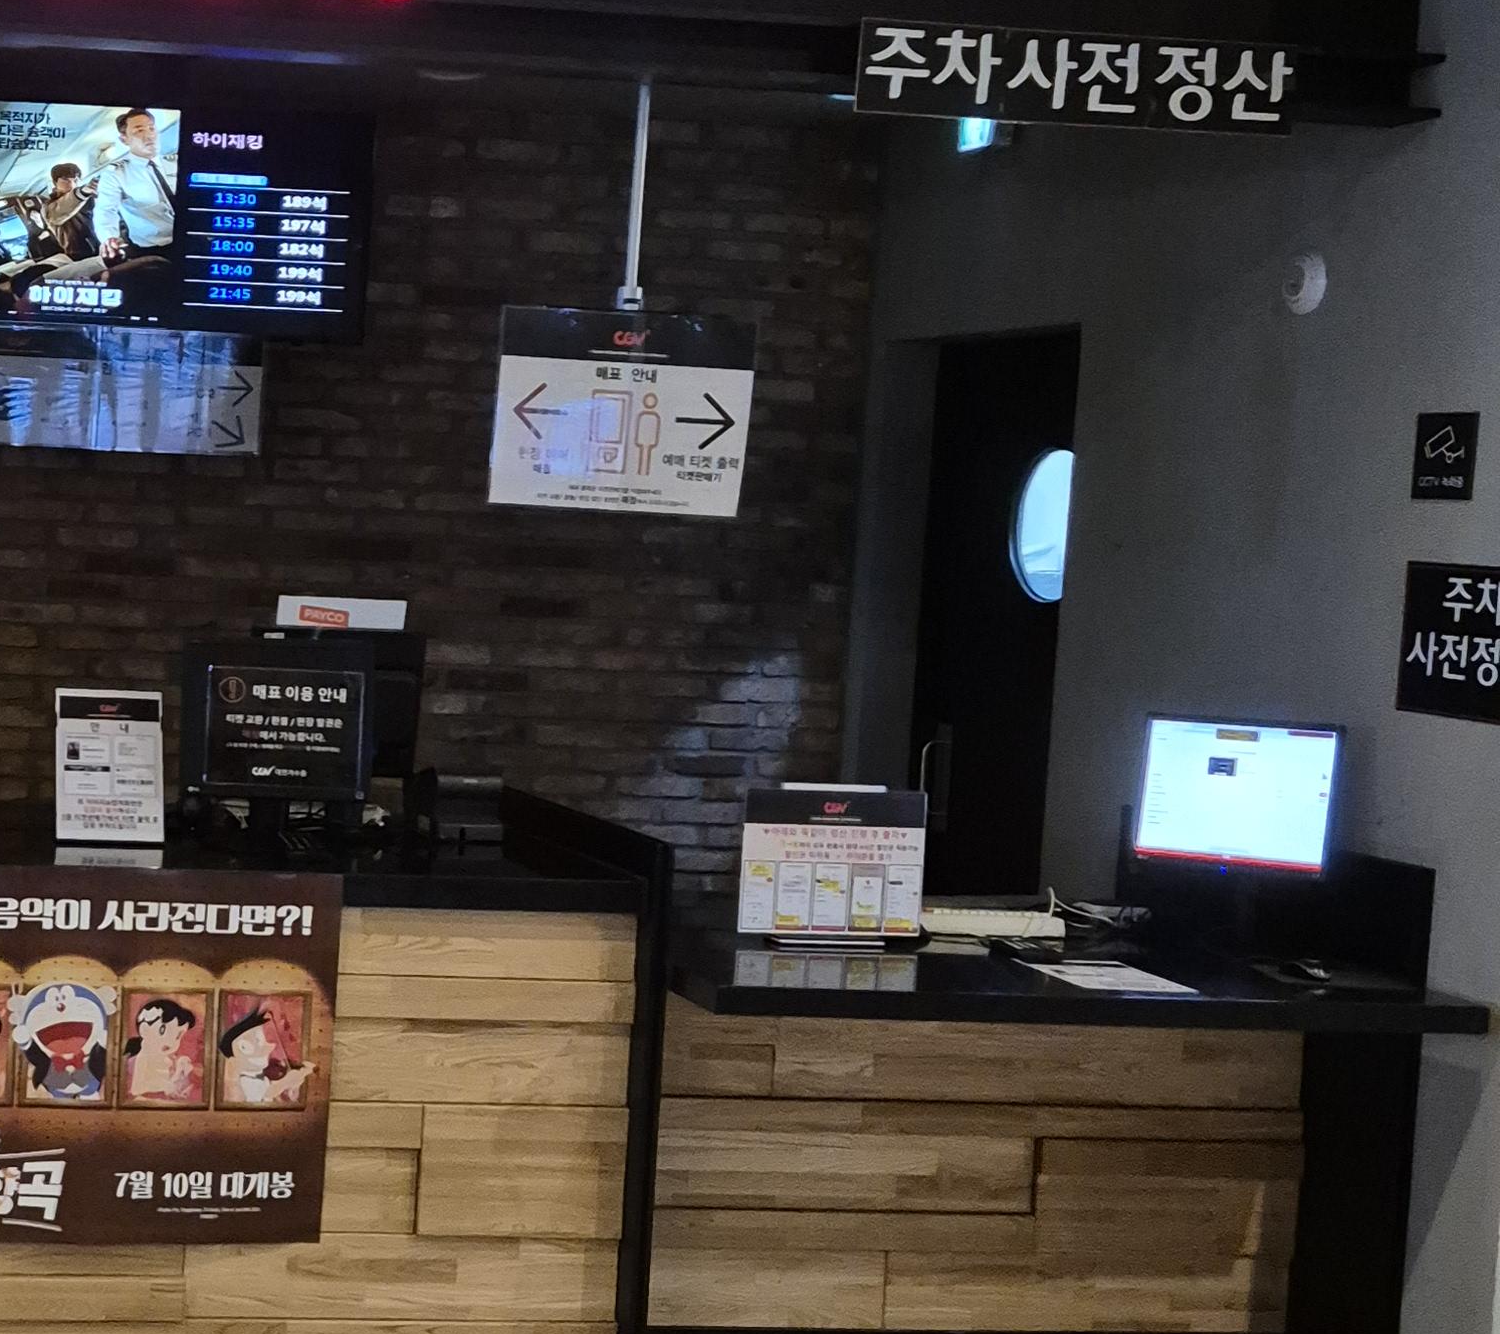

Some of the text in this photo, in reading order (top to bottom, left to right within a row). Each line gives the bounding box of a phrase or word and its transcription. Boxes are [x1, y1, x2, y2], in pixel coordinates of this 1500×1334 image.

[1154, 46, 1295, 122] 정산
[0, 110, 51, 125] 목적지가
[192, 131, 263, 150] 하이재킹
[214, 192, 257, 205] 13:30
[213, 216, 256, 229] 15:35
[212, 240, 255, 252] 18:00
[210, 263, 253, 276] 19:40
[208, 287, 251, 300] 21:45
[596, 366, 658, 384] 매표 안내
[252, 684, 348, 704] 매표 이용 안내
[97, 899, 315, 937] 사라진다면?!
[113, 1170, 296, 1200] 7월 10일 대개봉
